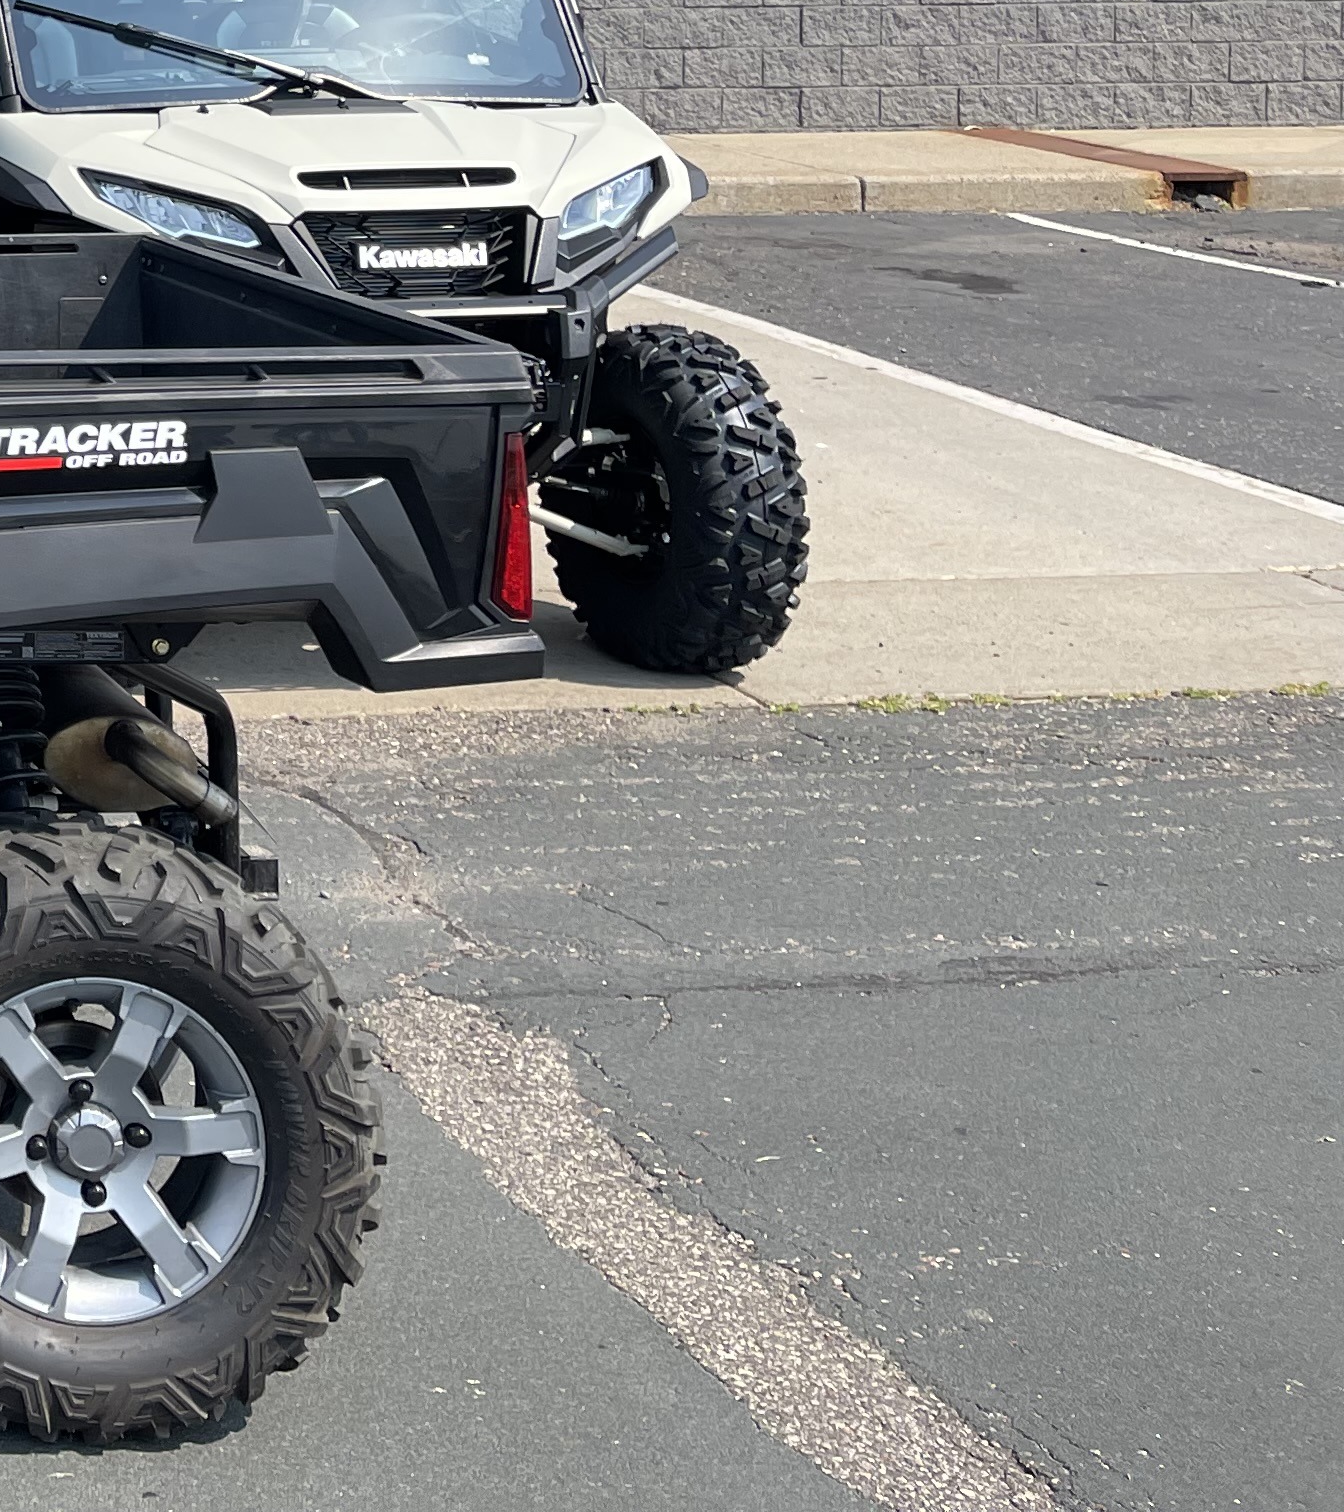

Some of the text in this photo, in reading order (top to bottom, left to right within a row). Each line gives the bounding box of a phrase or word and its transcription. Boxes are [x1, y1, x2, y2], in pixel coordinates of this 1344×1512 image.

[358, 242, 488, 269] Kawasaki
[65, 450, 188, 469] OFF ROAD
